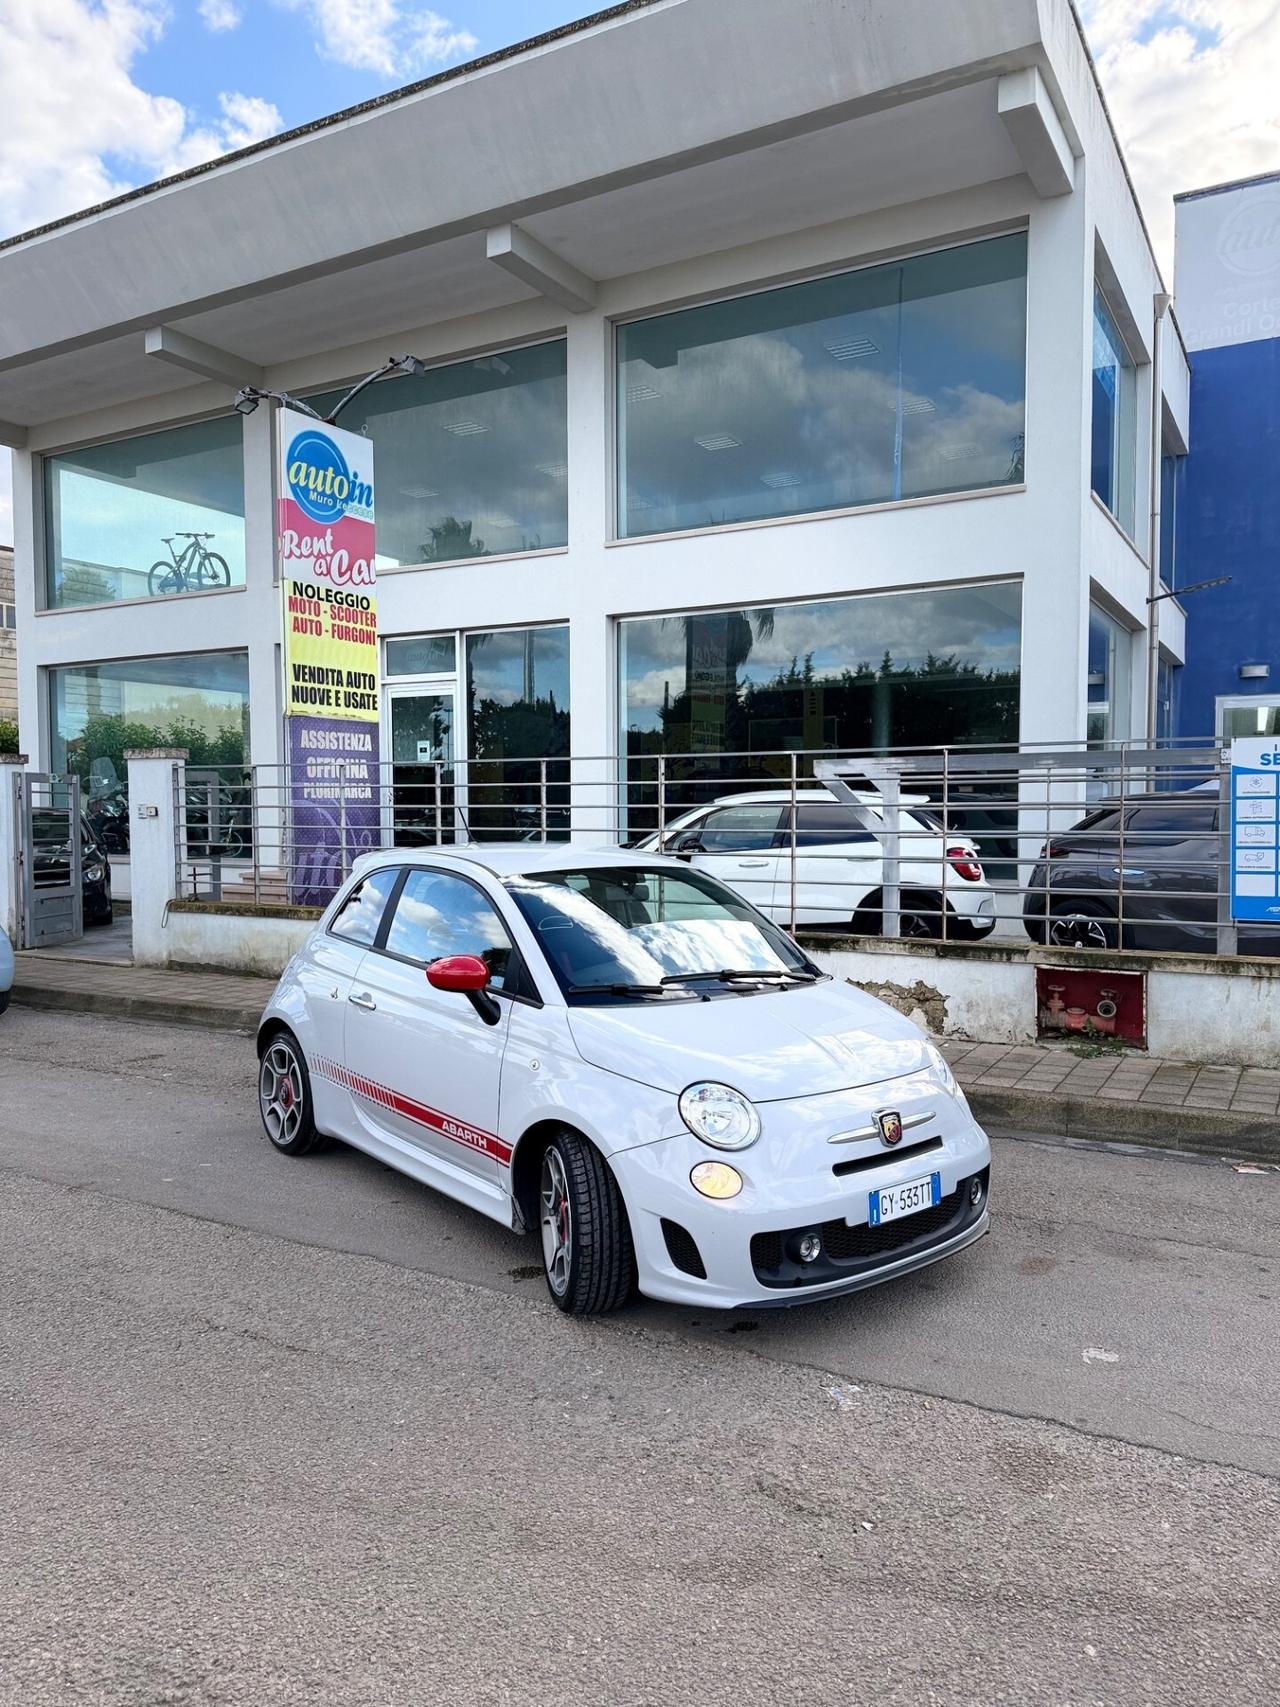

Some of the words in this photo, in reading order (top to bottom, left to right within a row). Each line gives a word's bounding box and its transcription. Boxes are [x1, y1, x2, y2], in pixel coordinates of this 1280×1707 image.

[1258, 313, 1280, 331] O
[308, 490, 333, 506] Muro
[283, 528, 334, 557] Rent
[315, 556, 331, 575] a
[293, 581, 370, 610] NOLEGGIO
[288, 596, 321, 617] MOTO
[330, 604, 376, 628] SCOOTER
[293, 616, 322, 636] AUTO
[331, 624, 376, 645] FURGONI
[292, 664, 344, 687] VENDITA
[346, 671, 375, 691] AUTO
[292, 685, 331, 706] NUOVE
[335, 690, 341, 707] E
[344, 690, 377, 710] USATE
[301, 730, 372, 751] ASSISTENZA
[307, 757, 368, 778] OFFICINA
[442, 1121, 487, 1148] ABARTH
